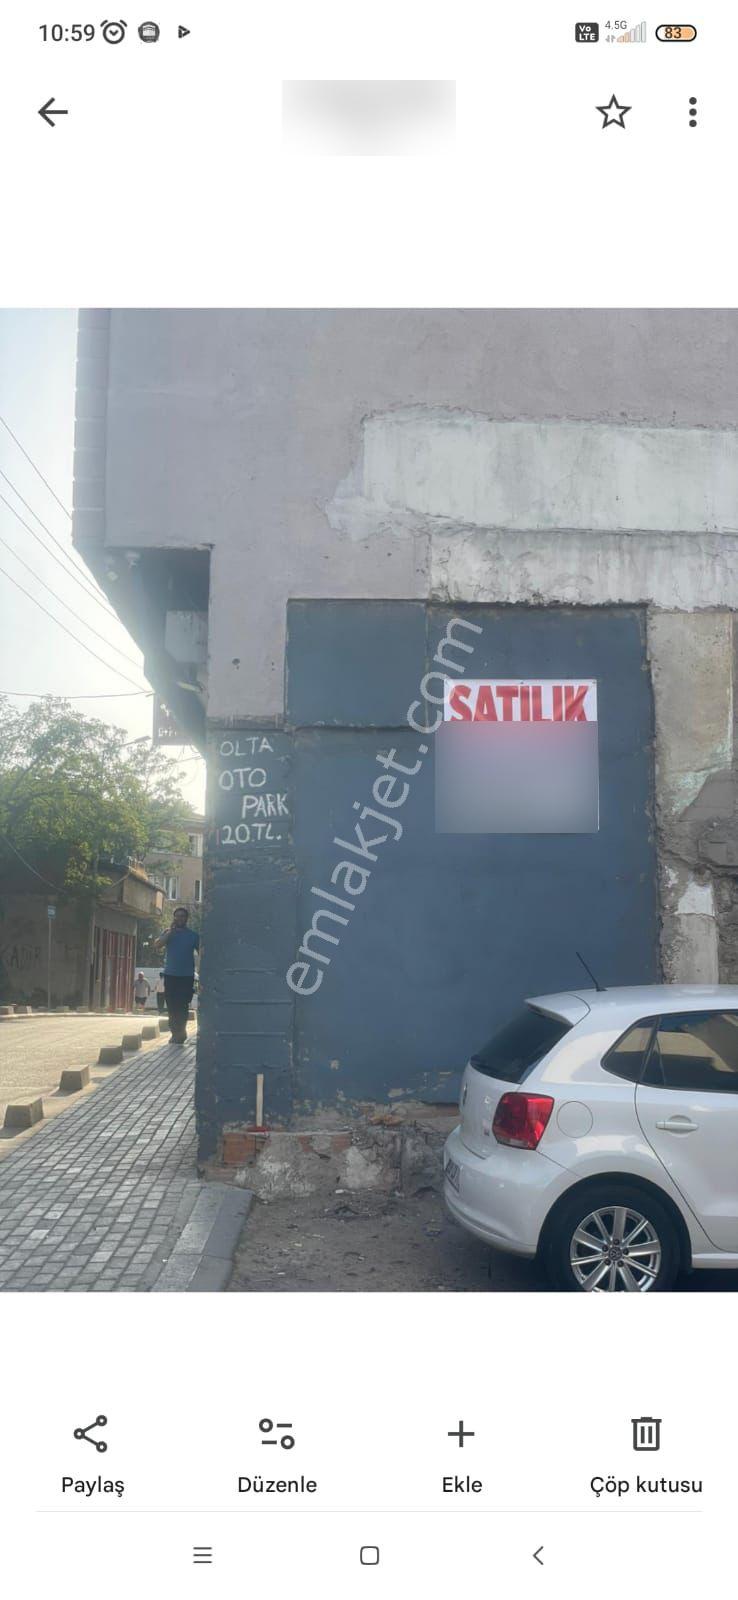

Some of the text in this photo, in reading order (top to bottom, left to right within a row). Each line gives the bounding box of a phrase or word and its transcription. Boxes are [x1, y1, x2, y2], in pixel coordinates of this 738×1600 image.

[39, 24, 95, 42] 10:59
[605, 20, 627, 30] 4.5G
[664, 26, 682, 39] 83
[579, 33, 596, 41] LTE
[449, 684, 589, 722] SATILIK
[220, 736, 274, 757] OLTA
[219, 767, 267, 791] OTO
[241, 793, 289, 819] PARK
[61, 1475, 125, 1498] Paylaş
[238, 1475, 318, 1493] Düzenle
[442, 1475, 483, 1493] Ekle
[590, 1475, 703, 1498] Çöp kutusu
